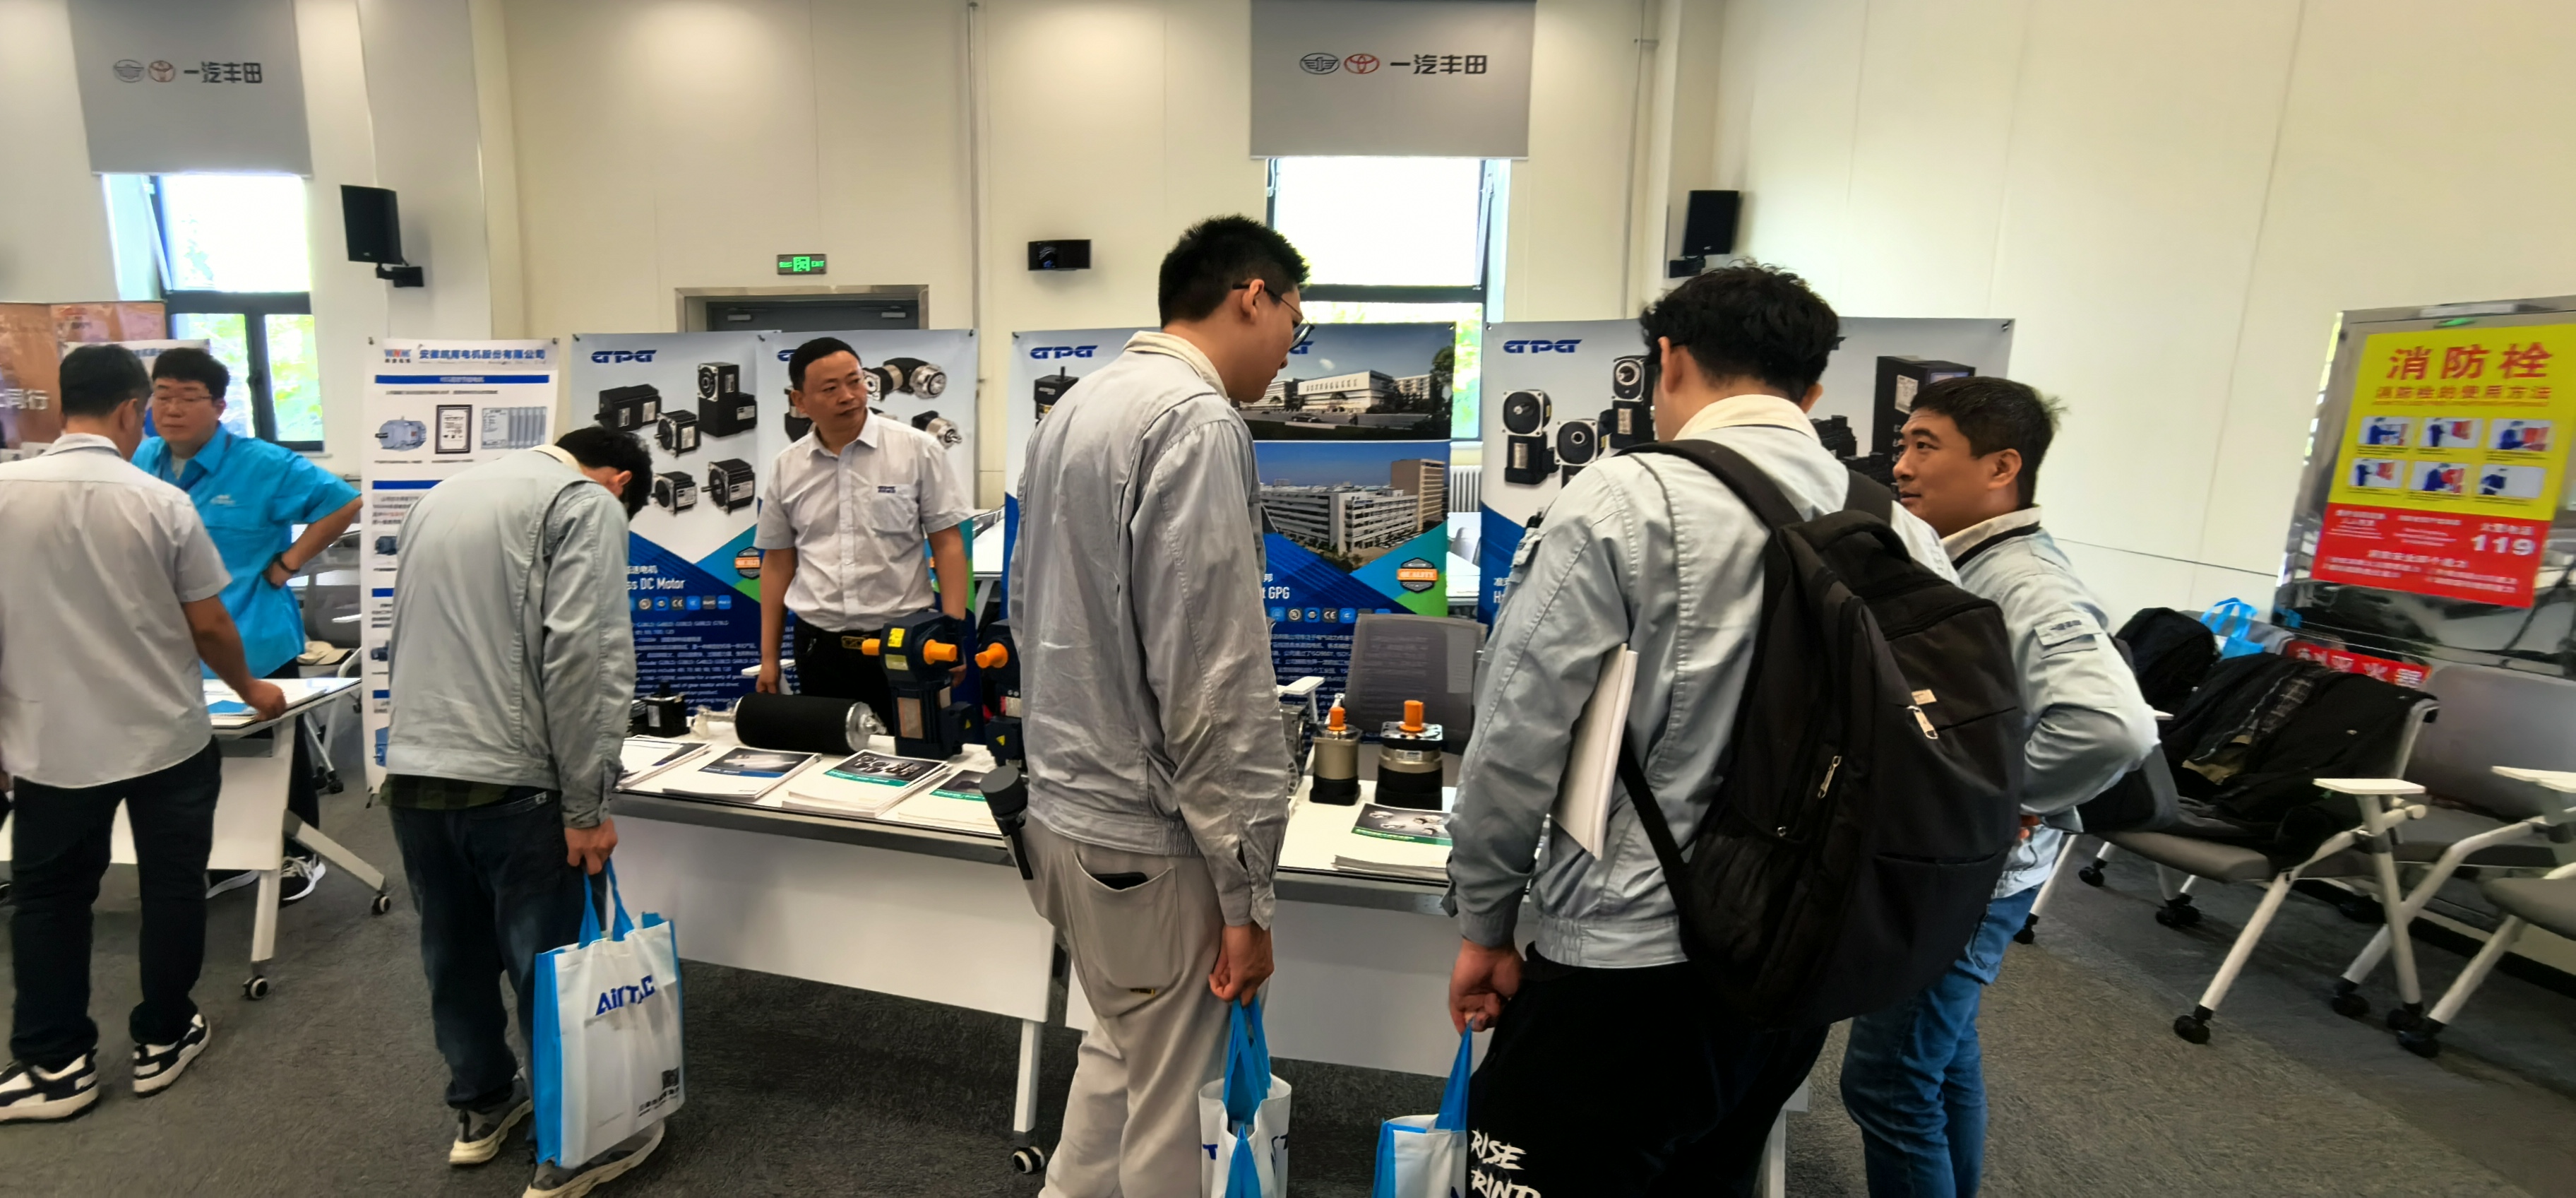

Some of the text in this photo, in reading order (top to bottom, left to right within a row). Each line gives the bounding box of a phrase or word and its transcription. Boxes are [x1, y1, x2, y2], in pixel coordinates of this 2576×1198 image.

[184, 61, 263, 83] 一汽丰田
[1390, 54, 1487, 75] 一汽丰田
[2385, 342, 2554, 380] 消防栓
[2471, 535, 2535, 556] 119
[640, 578, 655, 590] DC
[657, 577, 686, 590] Motor
[1268, 586, 1290, 599] GPG
[1471, 1128, 1527, 1170] RISE
